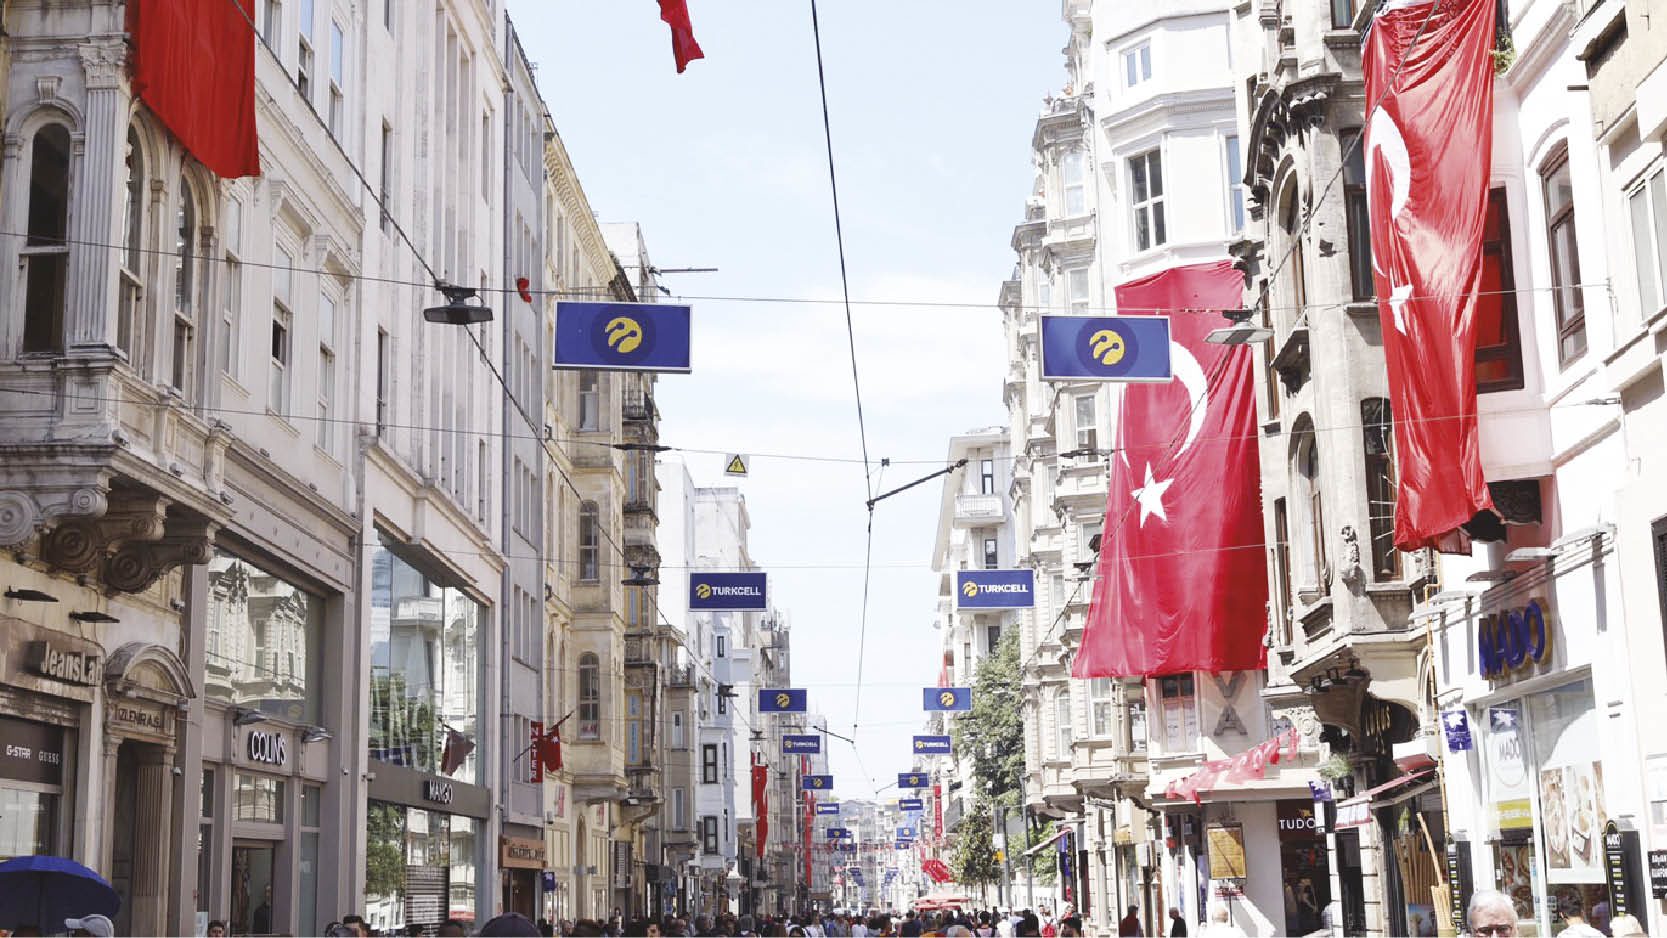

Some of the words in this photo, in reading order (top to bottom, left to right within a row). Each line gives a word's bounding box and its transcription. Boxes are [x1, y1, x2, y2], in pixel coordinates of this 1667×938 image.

[711, 586, 762, 596] TURKCELL
[978, 584, 1029, 593] TURKCELL
[1279, 817, 1316, 830] TUDO
